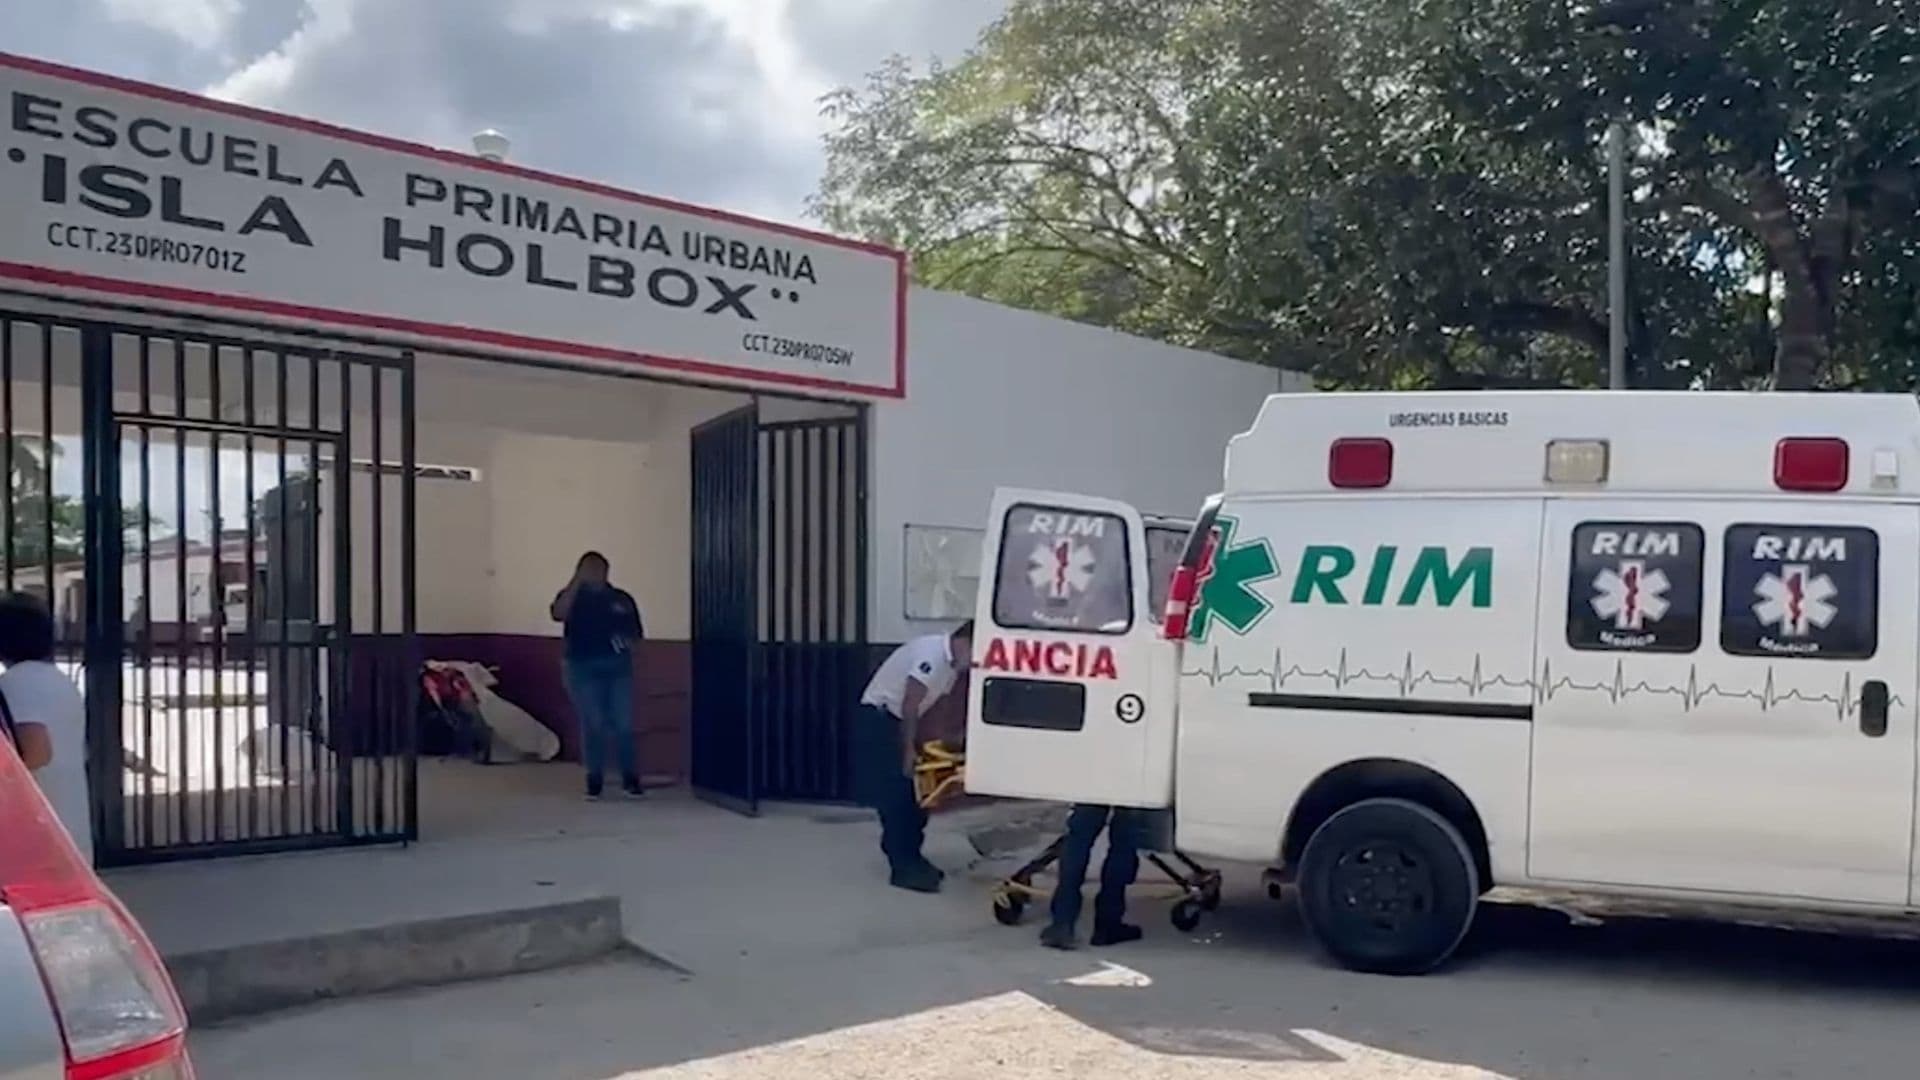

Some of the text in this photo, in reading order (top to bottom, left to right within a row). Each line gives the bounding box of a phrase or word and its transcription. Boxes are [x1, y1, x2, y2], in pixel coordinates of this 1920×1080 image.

[12, 91, 817, 285] ESCUELA PRIMARIA URBANA
[1389, 410, 1509, 428] URGENCIAS BASICAS
[1028, 513, 1104, 539] RIM
[1592, 531, 1681, 556] RIM
[1751, 534, 1847, 562] RIM
[1290, 545, 1494, 608] RIM
[970, 637, 1118, 680] ANCIA
